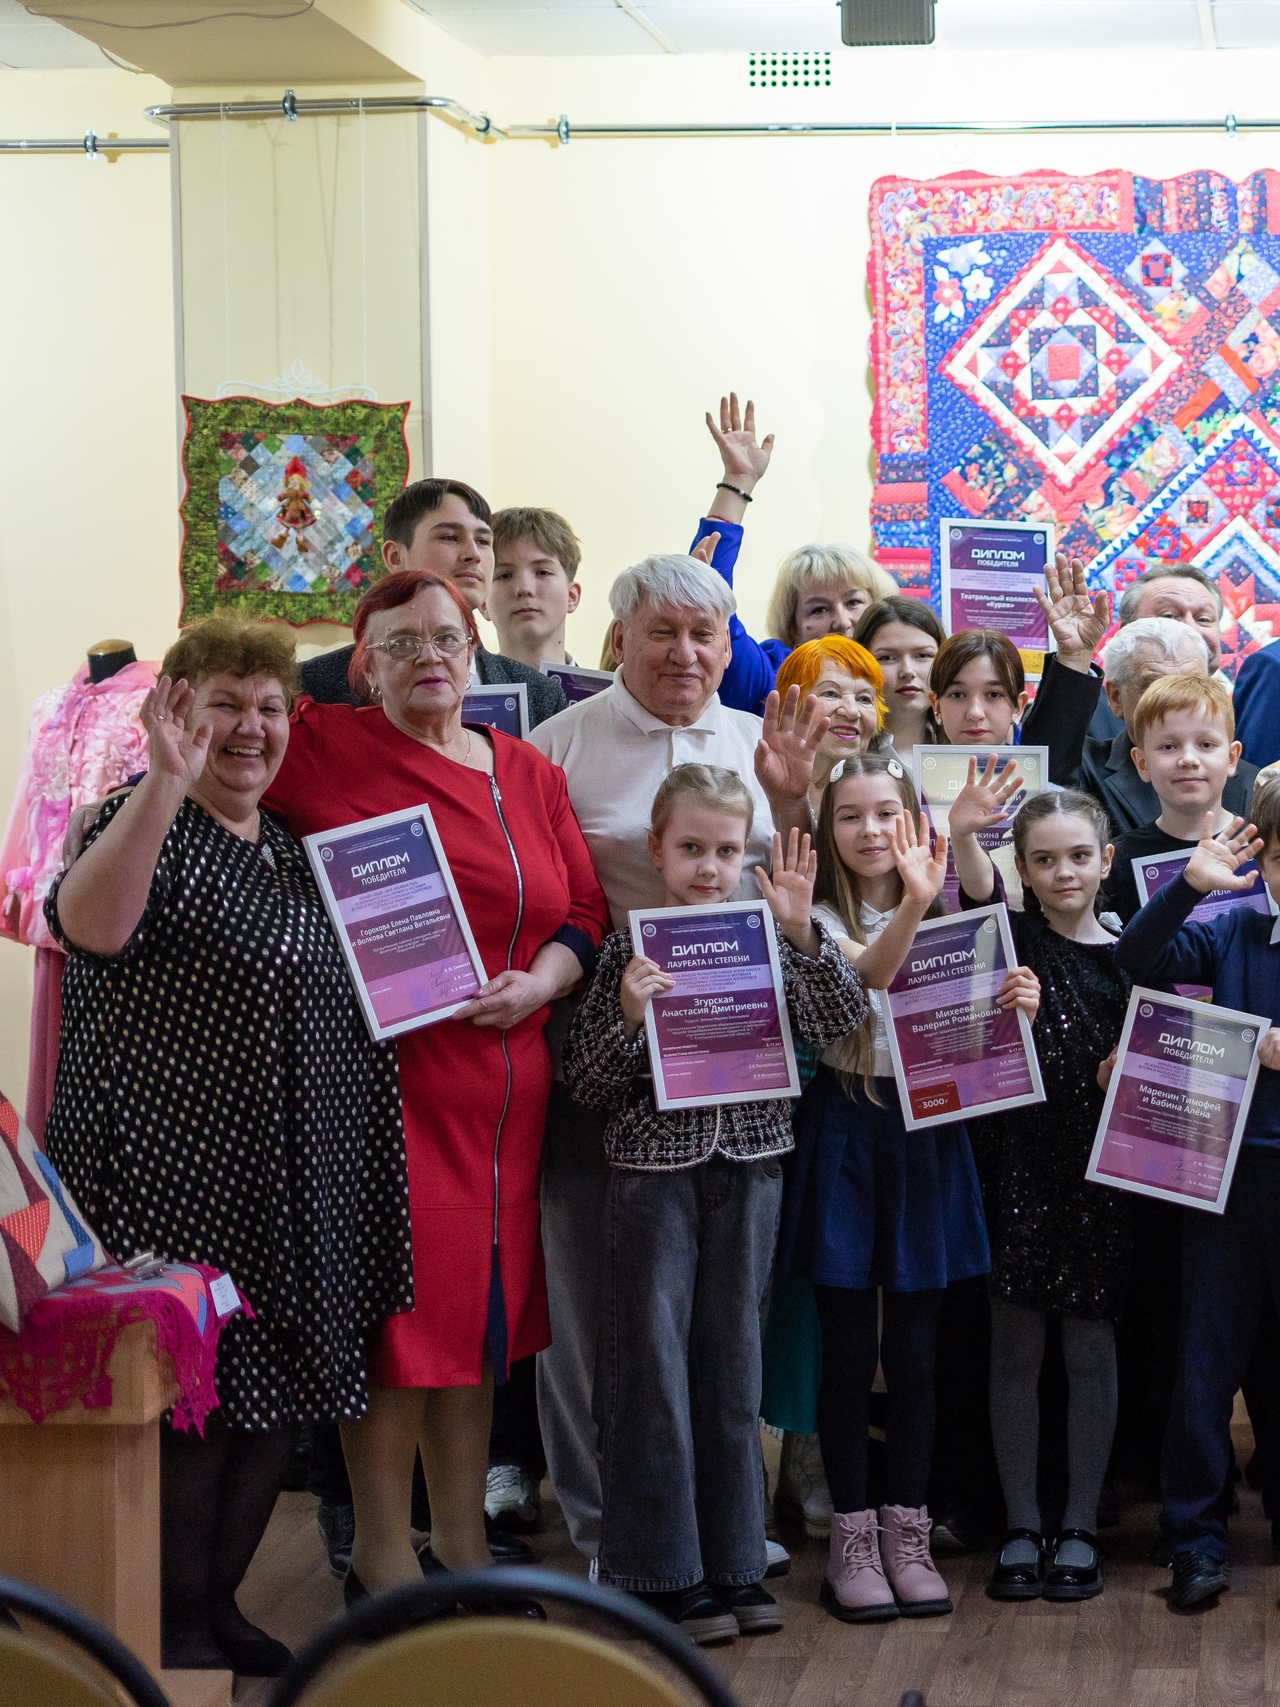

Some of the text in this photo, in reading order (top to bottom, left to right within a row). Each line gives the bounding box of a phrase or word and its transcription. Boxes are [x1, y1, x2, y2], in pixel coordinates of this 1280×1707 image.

[971, 548, 1024, 560] ДИПЛОМ
[977, 559, 1018, 568] ПОБЕДИТЕЛЯ
[960, 593, 1004, 601] Театральный
[349, 851, 410, 877] ДИПЛОМ
[361, 867, 407, 886] ПОБЕДИТЕЛЯ
[356, 932, 383, 945] Волкова
[384, 923, 413, 937] Светлана
[413, 912, 450, 928] Витальевна
[360, 908, 440, 937] Горохова Елена Павловна
[671, 940, 738, 955] ДИПЛОМ
[667, 959, 706, 968] ЛАУРЕАТА
[714, 955, 749, 963] СТЕПЕНИ
[911, 948, 976, 971] ДИПЛОМ
[907, 970, 945, 985] ЛАУРЕАТА
[951, 961, 985, 975] СТЕПЕНИ
[661, 1001, 768, 1017] Анастасия Дмитриевна
[694, 995, 733, 1007] Згурская
[912, 1018, 949, 1034] Валерия
[952, 1006, 1001, 1023] Романовна
[935, 1004, 974, 1018] Михеева
[1158, 1032, 1224, 1057] ДИПЛОМ
[1163, 1046, 1214, 1065] ПОБЕДИТЕЛЯ
[922, 1097, 944, 1108] 3000
[1138, 1084, 1220, 1112] Маренин Тимофей
[1150, 1097, 1182, 1111] Бабина
[1183, 1106, 1210, 1118] Алёна
